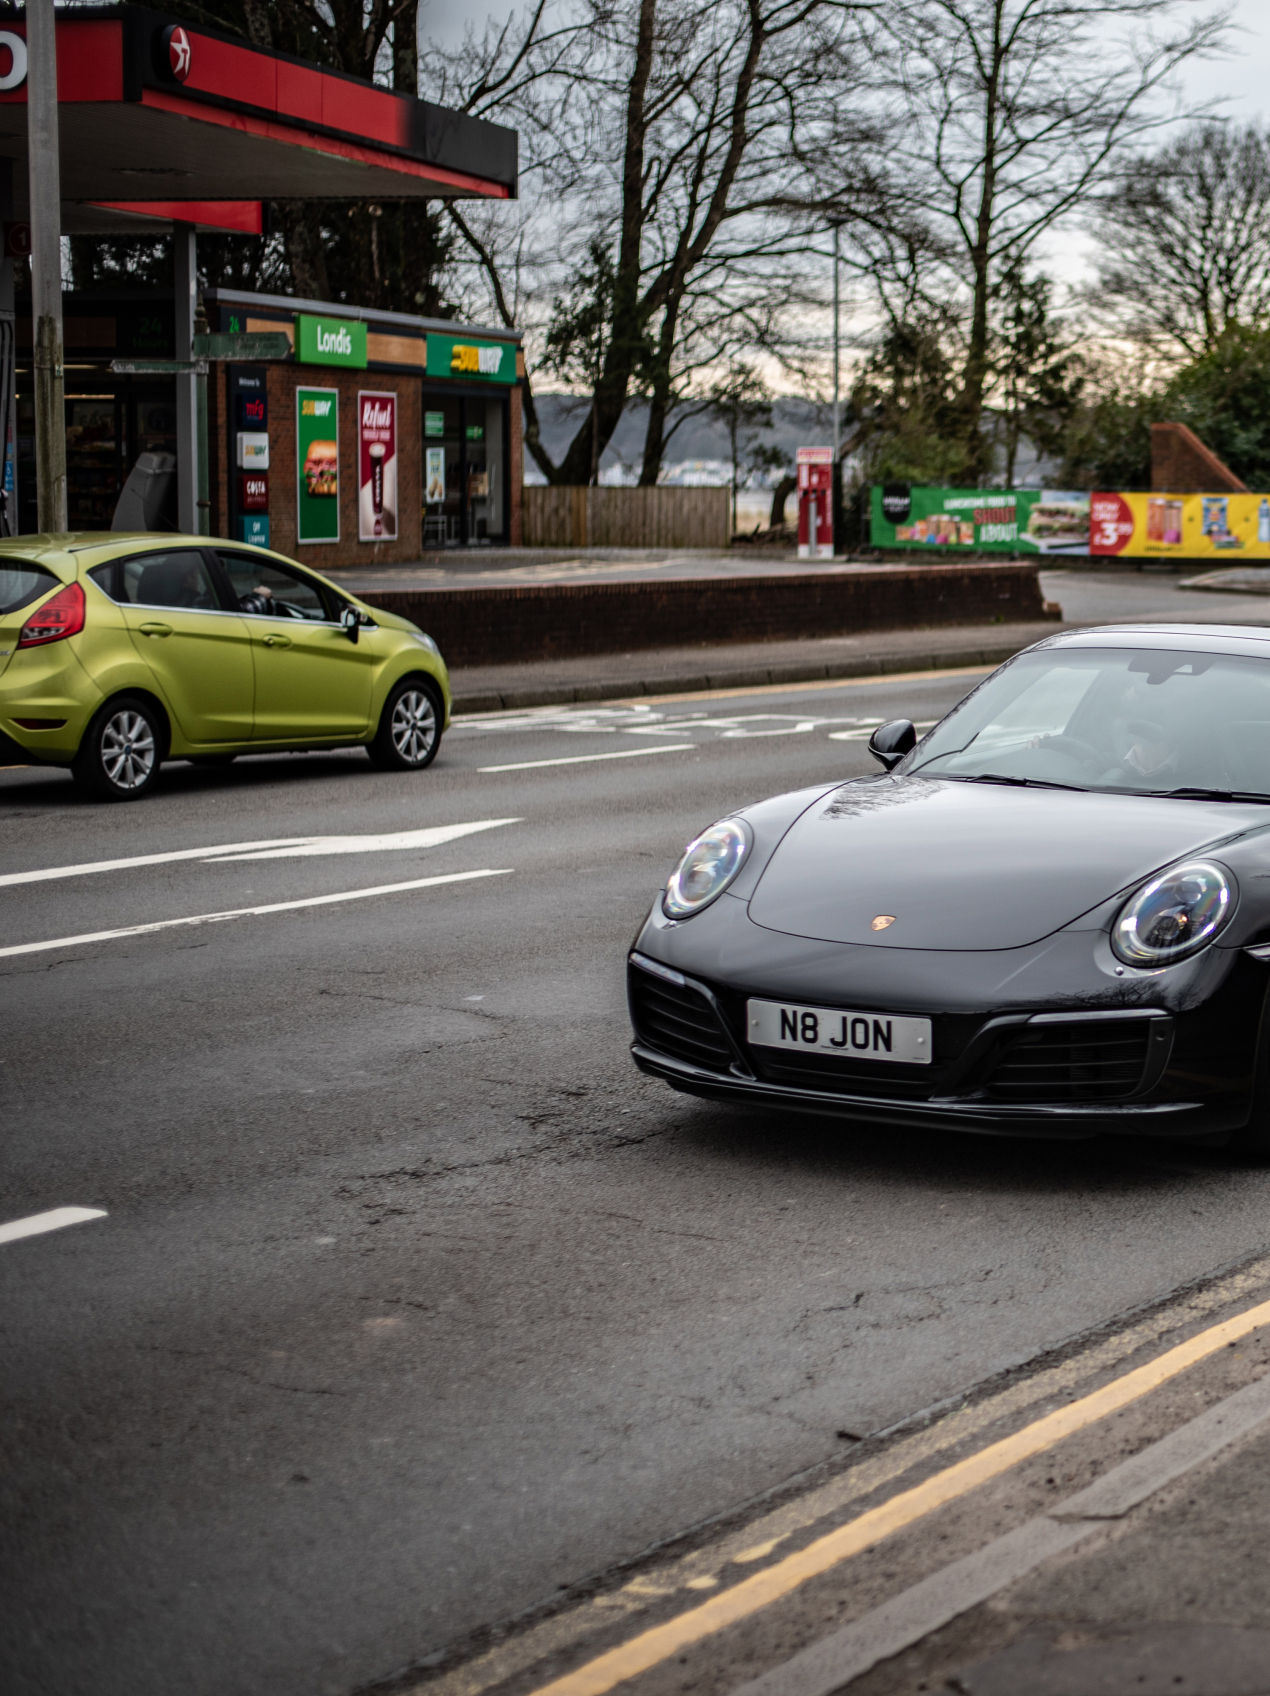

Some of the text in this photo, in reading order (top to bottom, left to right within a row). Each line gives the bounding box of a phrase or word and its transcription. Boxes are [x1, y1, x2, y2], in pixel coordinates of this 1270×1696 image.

[18, 231, 27, 247] 1
[139, 317, 163, 334] 24
[132, 337, 169, 348] Hours
[317, 325, 351, 355] Londis
[452, 344, 504, 375] SUBWAY
[245, 399, 265, 420] mfg
[302, 399, 332, 418] SUBWAY
[362, 401, 391, 429] Refuel
[245, 444, 268, 457] SUBWAY
[246, 480, 266, 496] COSTA
[974, 506, 1016, 525] SHOUT
[980, 523, 1018, 542] ABOUT
[780, 1008, 893, 1052] N8 JON
